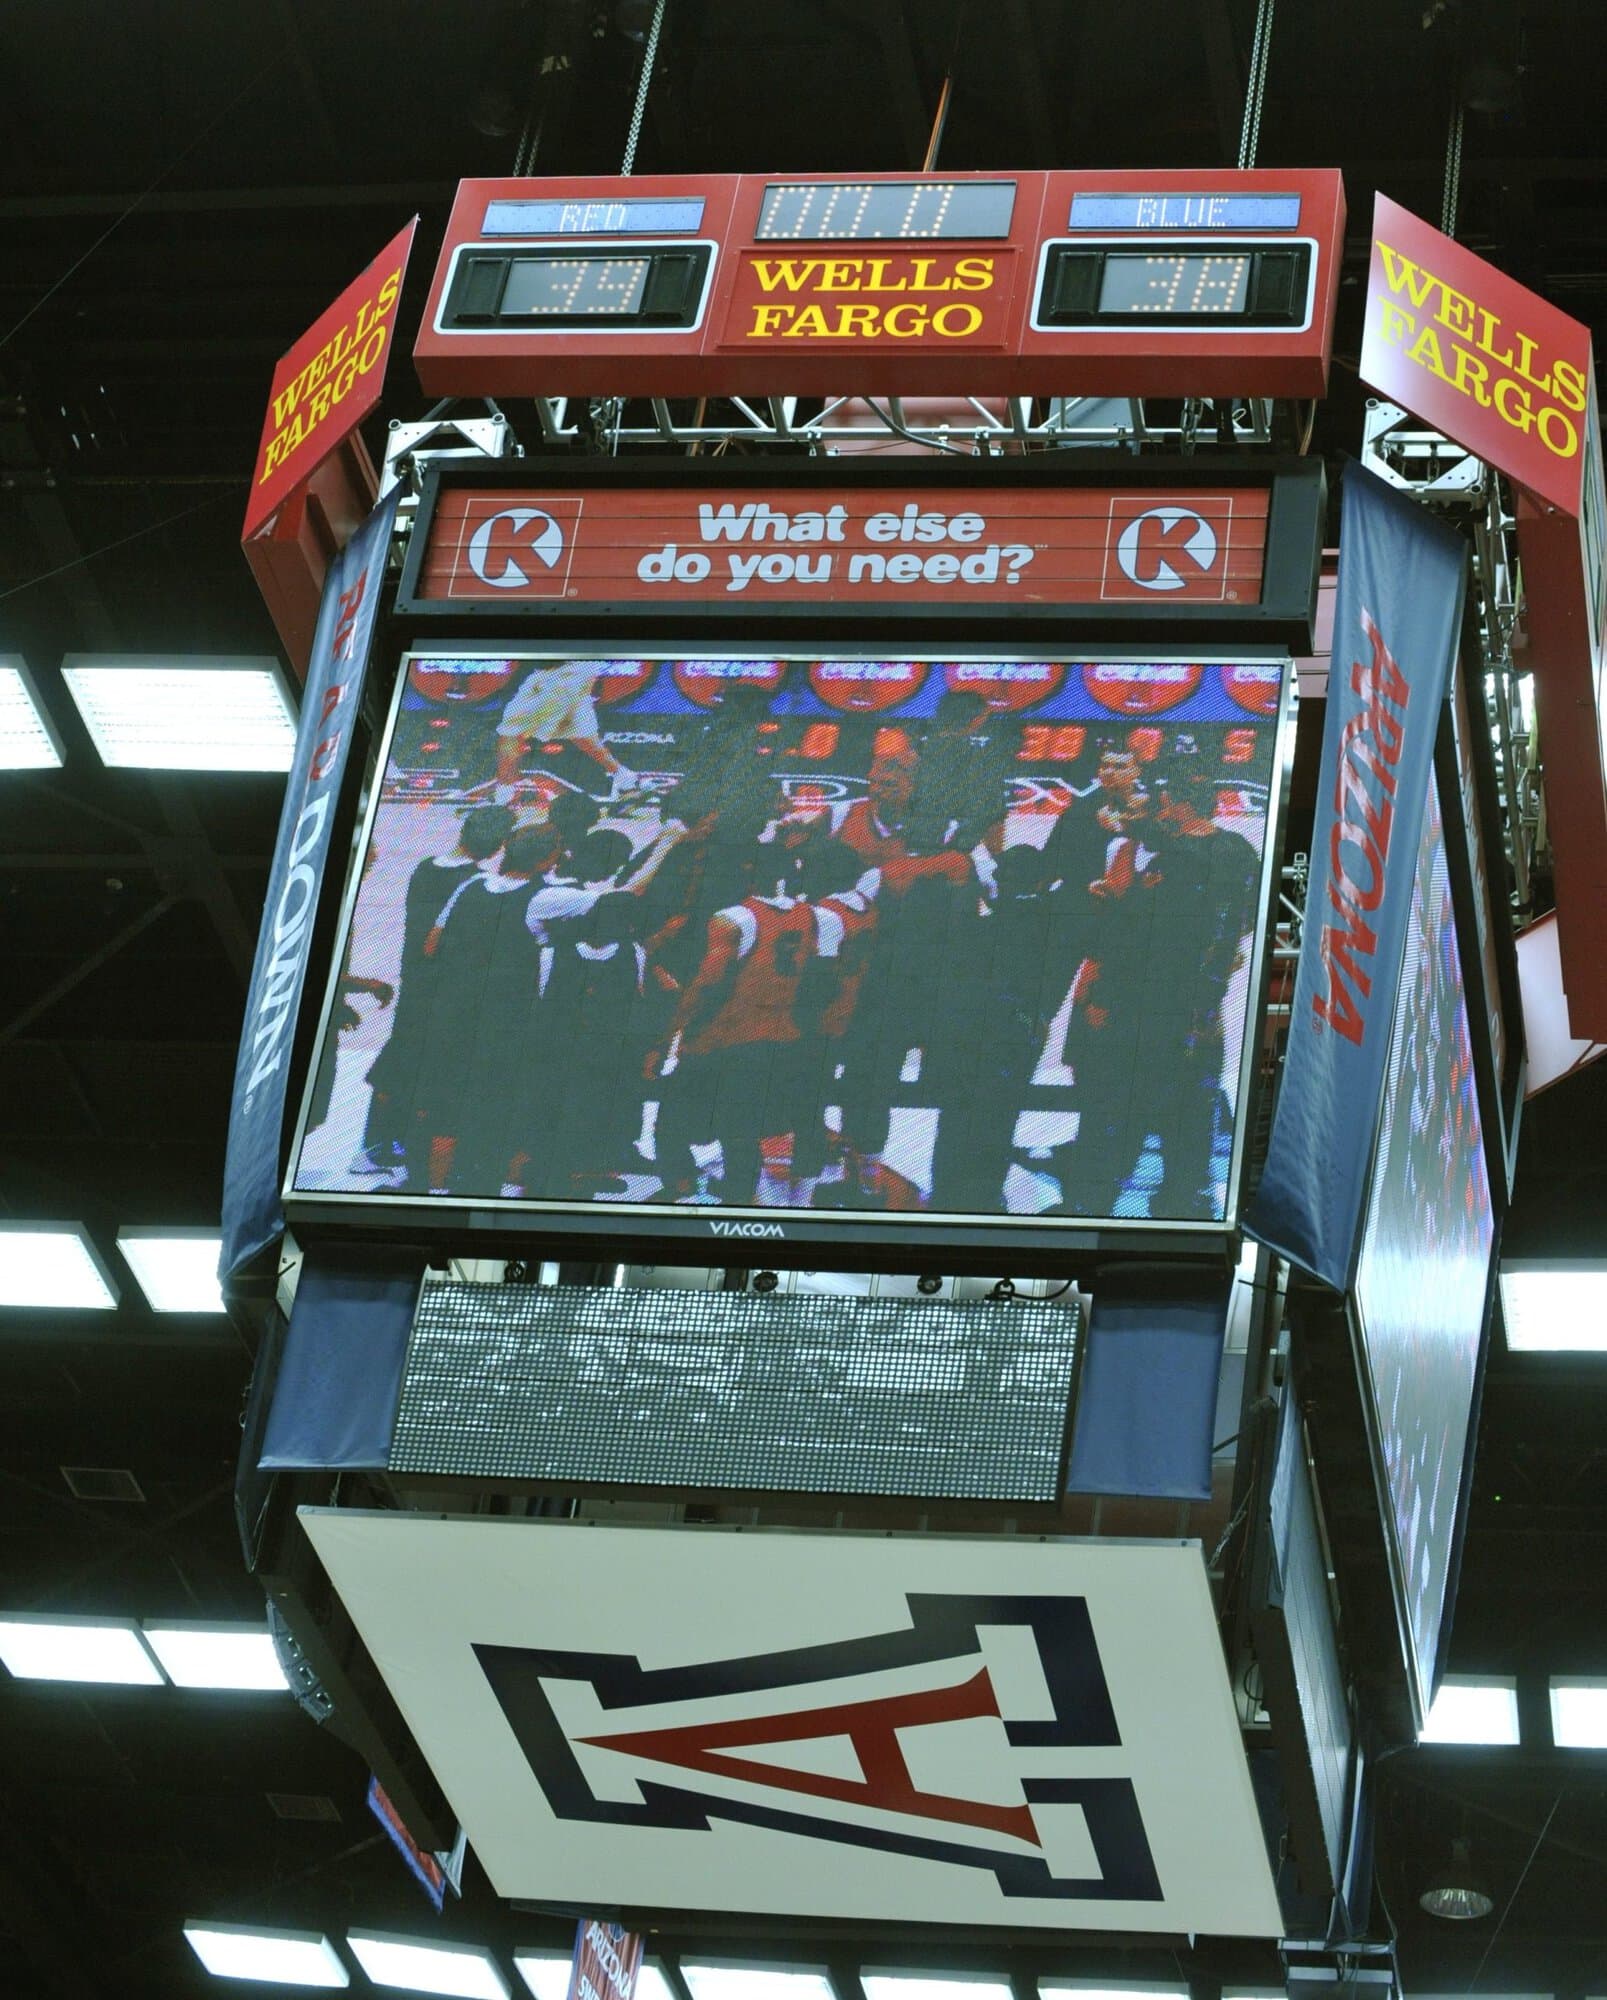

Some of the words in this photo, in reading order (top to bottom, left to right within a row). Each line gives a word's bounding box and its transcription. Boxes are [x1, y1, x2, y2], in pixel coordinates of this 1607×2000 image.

[559, 204, 626, 232] RED
[1136, 198, 1229, 228] BLUE
[531, 261, 645, 313] 39
[750, 257, 994, 292] WELLS
[1131, 256, 1246, 313] 38
[746, 303, 984, 338] FARGO
[1375, 240, 1588, 413] WELLS
[272, 267, 401, 429] WELLS
[1376, 295, 1579, 459] FARGO
[258, 325, 387, 486] FARGO
[698, 503, 849, 542] What
[864, 503, 986, 543] else
[636, 544, 711, 583] do
[726, 553, 833, 592] you
[848, 543, 1035, 584] need?
[1311, 604, 1412, 1048] ARIZONA
[244, 791, 331, 1096] DOWN
[709, 1221, 785, 1238] VIACOM
[470, 1592, 1165, 1903] A
